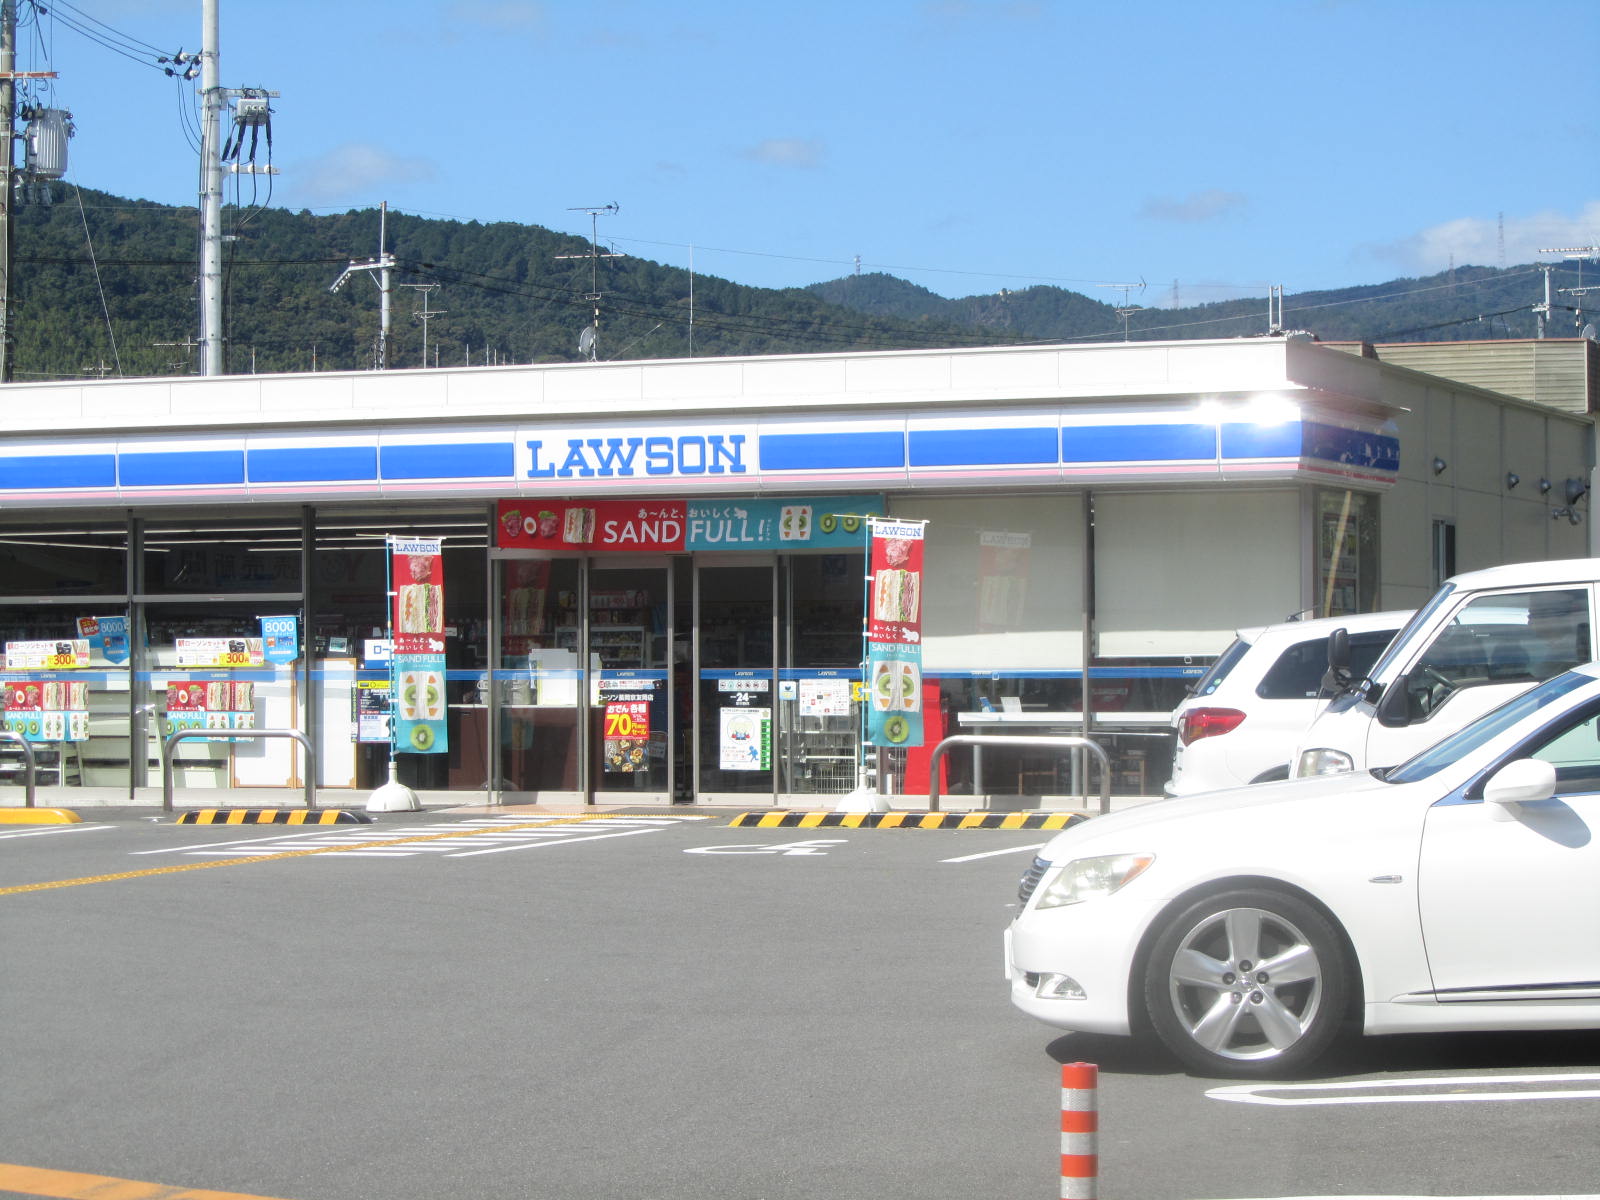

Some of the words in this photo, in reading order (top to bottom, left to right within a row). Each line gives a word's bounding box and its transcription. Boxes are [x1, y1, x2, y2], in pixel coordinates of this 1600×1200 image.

[526, 434, 746, 478] LAWSON
[602, 520, 681, 544] SAND
[690, 519, 765, 543] FULL!
[875, 525, 922, 537] LAWSON
[395, 543, 439, 553] LAWSON
[100, 622, 123, 633] 8000
[264, 620, 295, 633] 8000
[871, 643, 896, 652] SAND
[398, 654, 422, 663] SAND
[736, 692, 749, 702] 24
[607, 705, 629, 714] おでん
[606, 713, 632, 736] 70
